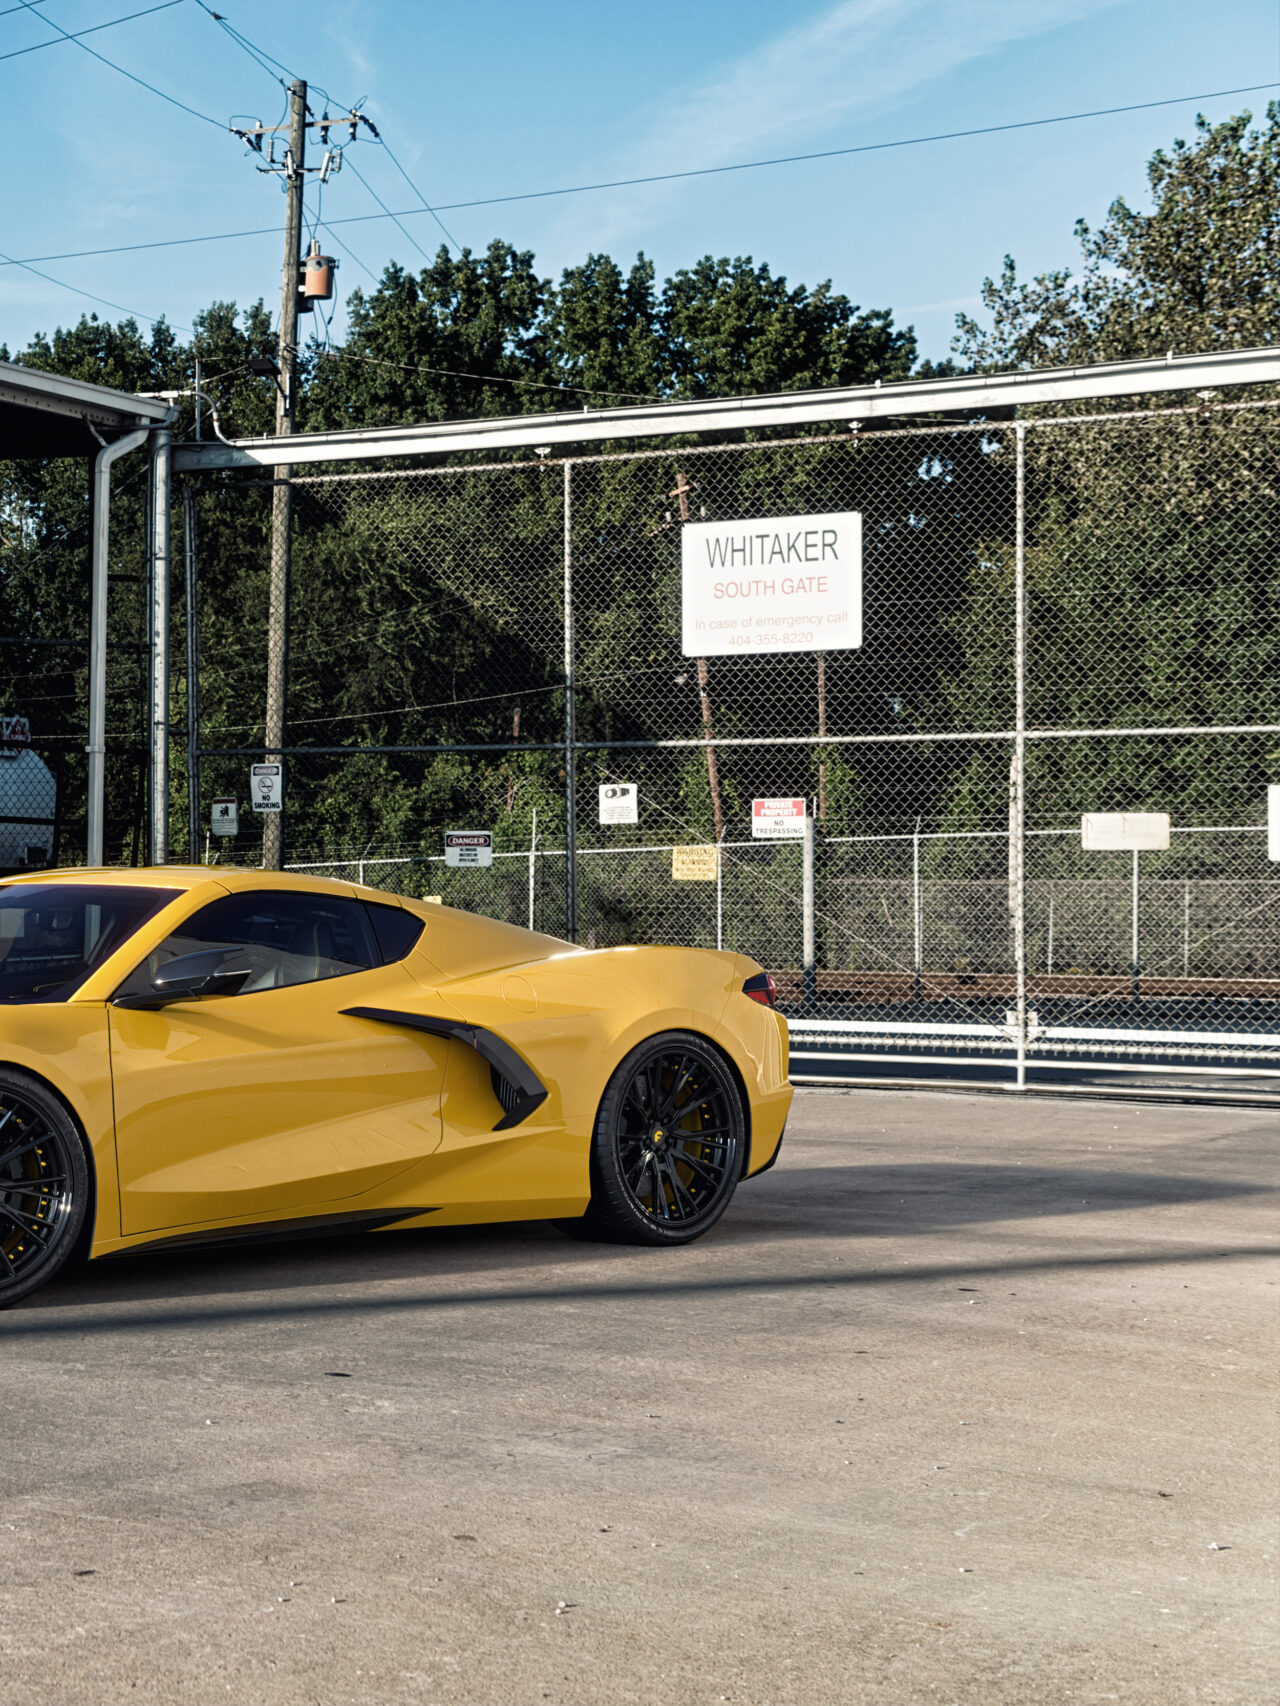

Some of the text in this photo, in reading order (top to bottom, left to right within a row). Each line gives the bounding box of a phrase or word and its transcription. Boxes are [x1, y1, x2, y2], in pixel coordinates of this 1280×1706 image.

[706, 530, 839, 568] WHITAKER
[713, 576, 828, 599] SOUTH GATE
[709, 618, 737, 630] case
[741, 616, 753, 628] of
[755, 614, 823, 629] emergency
[827, 611, 848, 624] call
[728, 632, 813, 646] 404-355-8220
